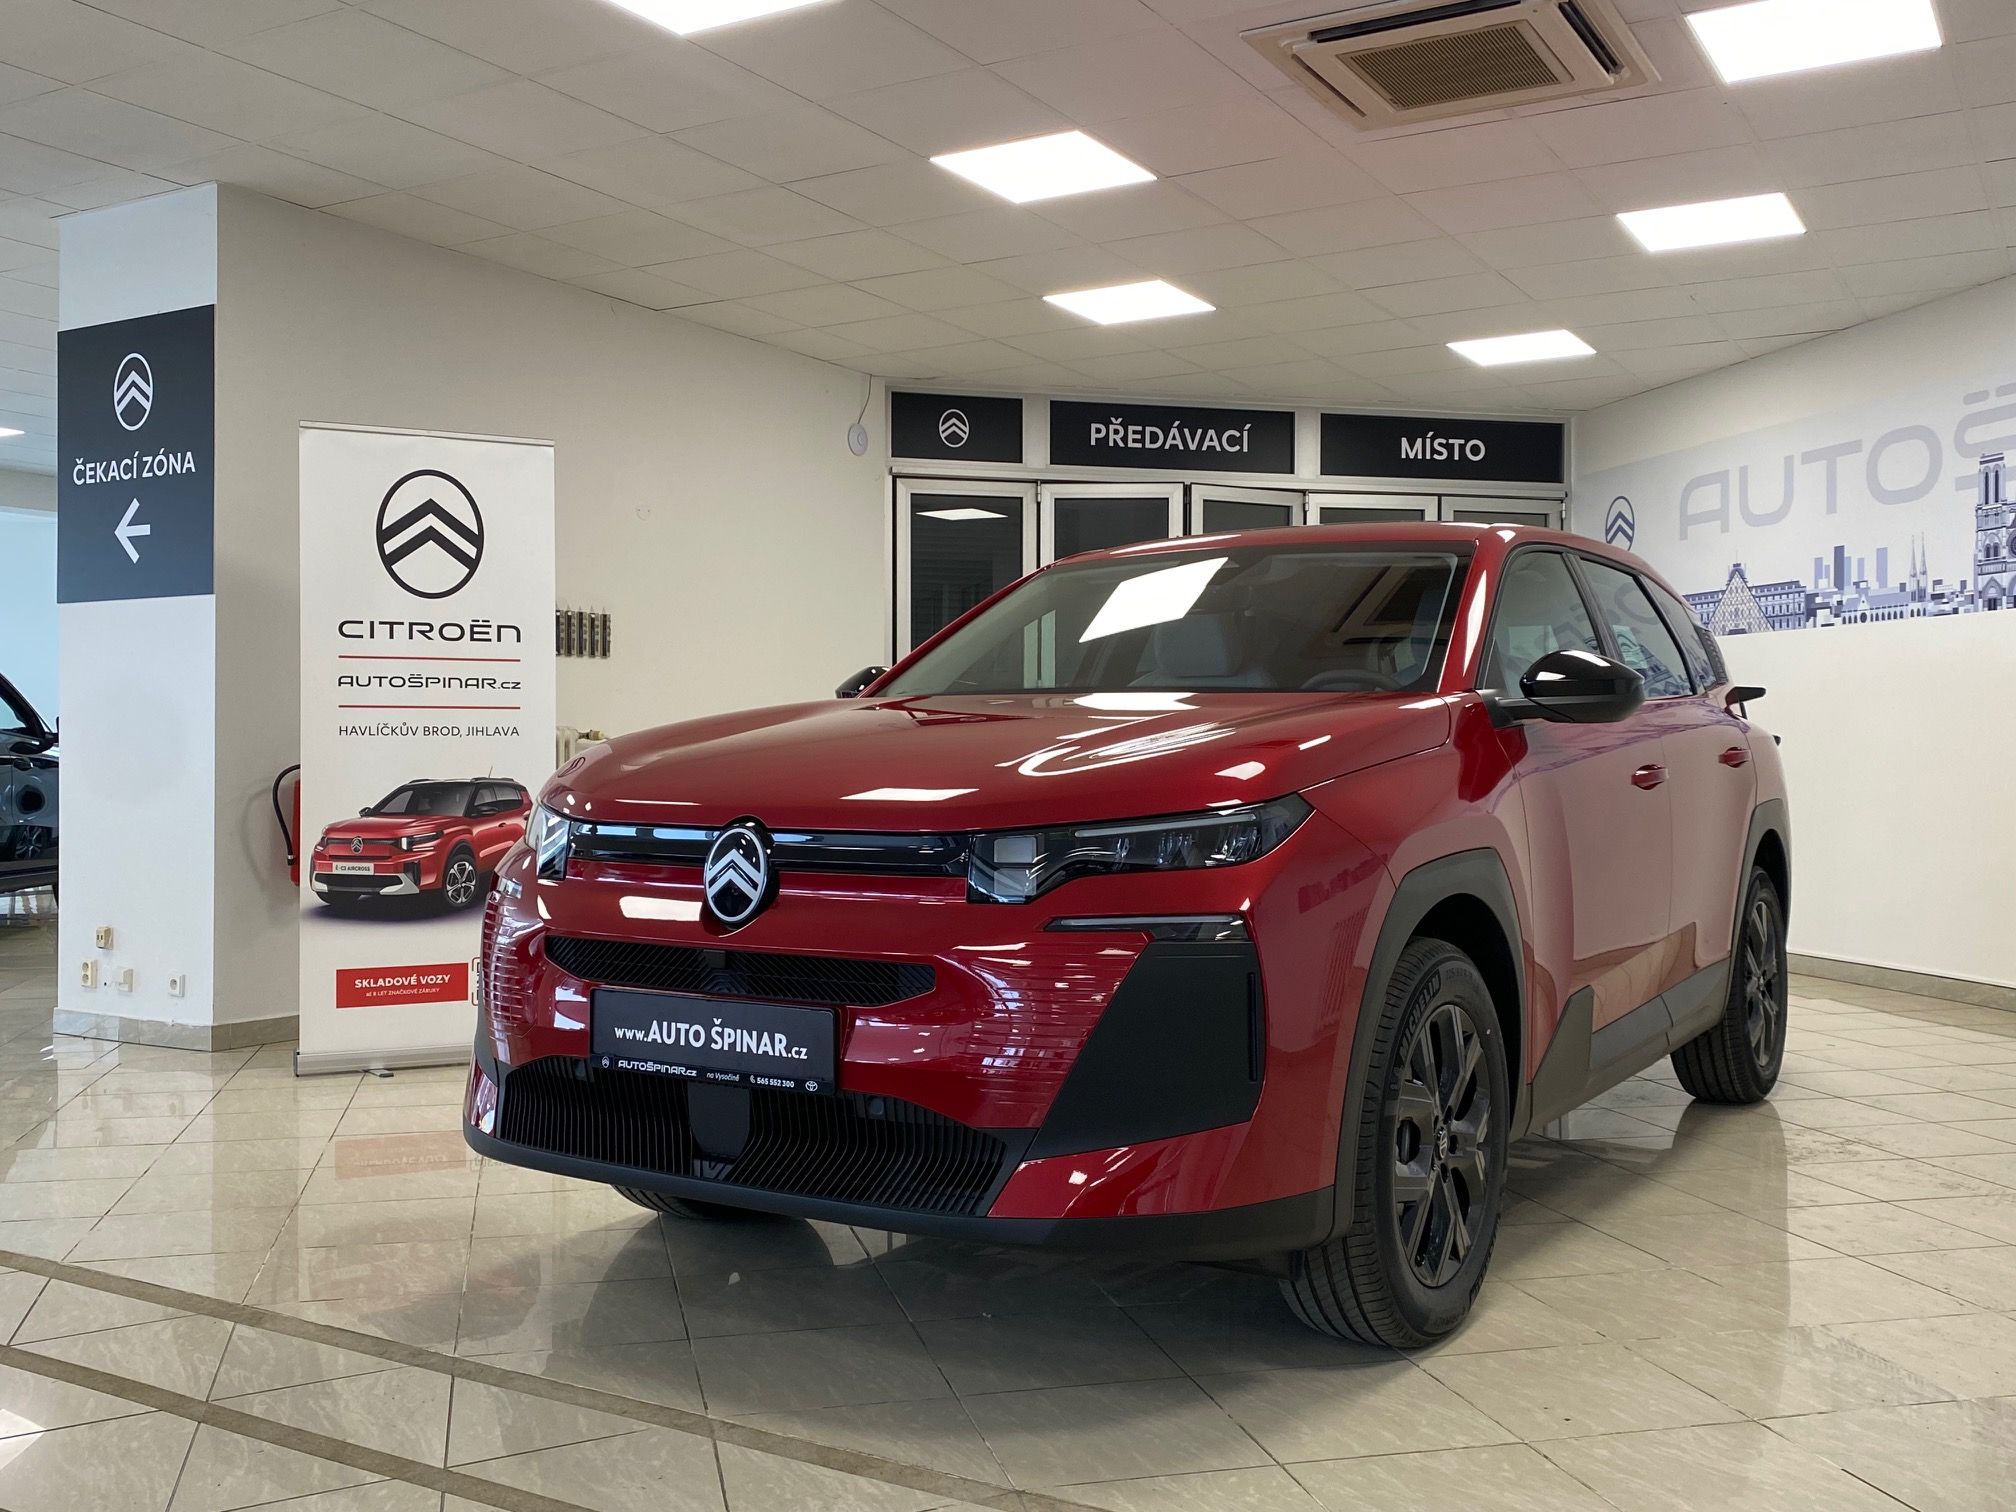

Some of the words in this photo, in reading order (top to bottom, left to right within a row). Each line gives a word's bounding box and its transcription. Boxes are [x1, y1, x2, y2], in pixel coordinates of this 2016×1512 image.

[1089, 417, 1251, 453] PŘEDÁVACÍ
[1399, 431, 1487, 462] MÍSTO
[72, 451, 139, 485] ČEKACÍ
[142, 448, 196, 478] ZÓNA
[338, 619, 521, 643] CITROËN
[337, 673, 521, 690] AUTOŠPINAR.cz
[338, 722, 419, 737] HAVLÍČKŮV
[422, 725, 463, 738] BROD,
[465, 726, 520, 737] JIHLAVA
[354, 974, 418, 988] SKLADOVÉ
[419, 974, 451, 984] VOZY
[614, 1020, 706, 1047] www.AUTO
[710, 1018, 808, 1060] ŠPINAR.cz
[618, 1060, 697, 1076] AUTOŠPINAR.cz
[757, 1077, 770, 1085] 565
[770, 1078, 782, 1086] 552
[782, 1080, 795, 1088] 300
